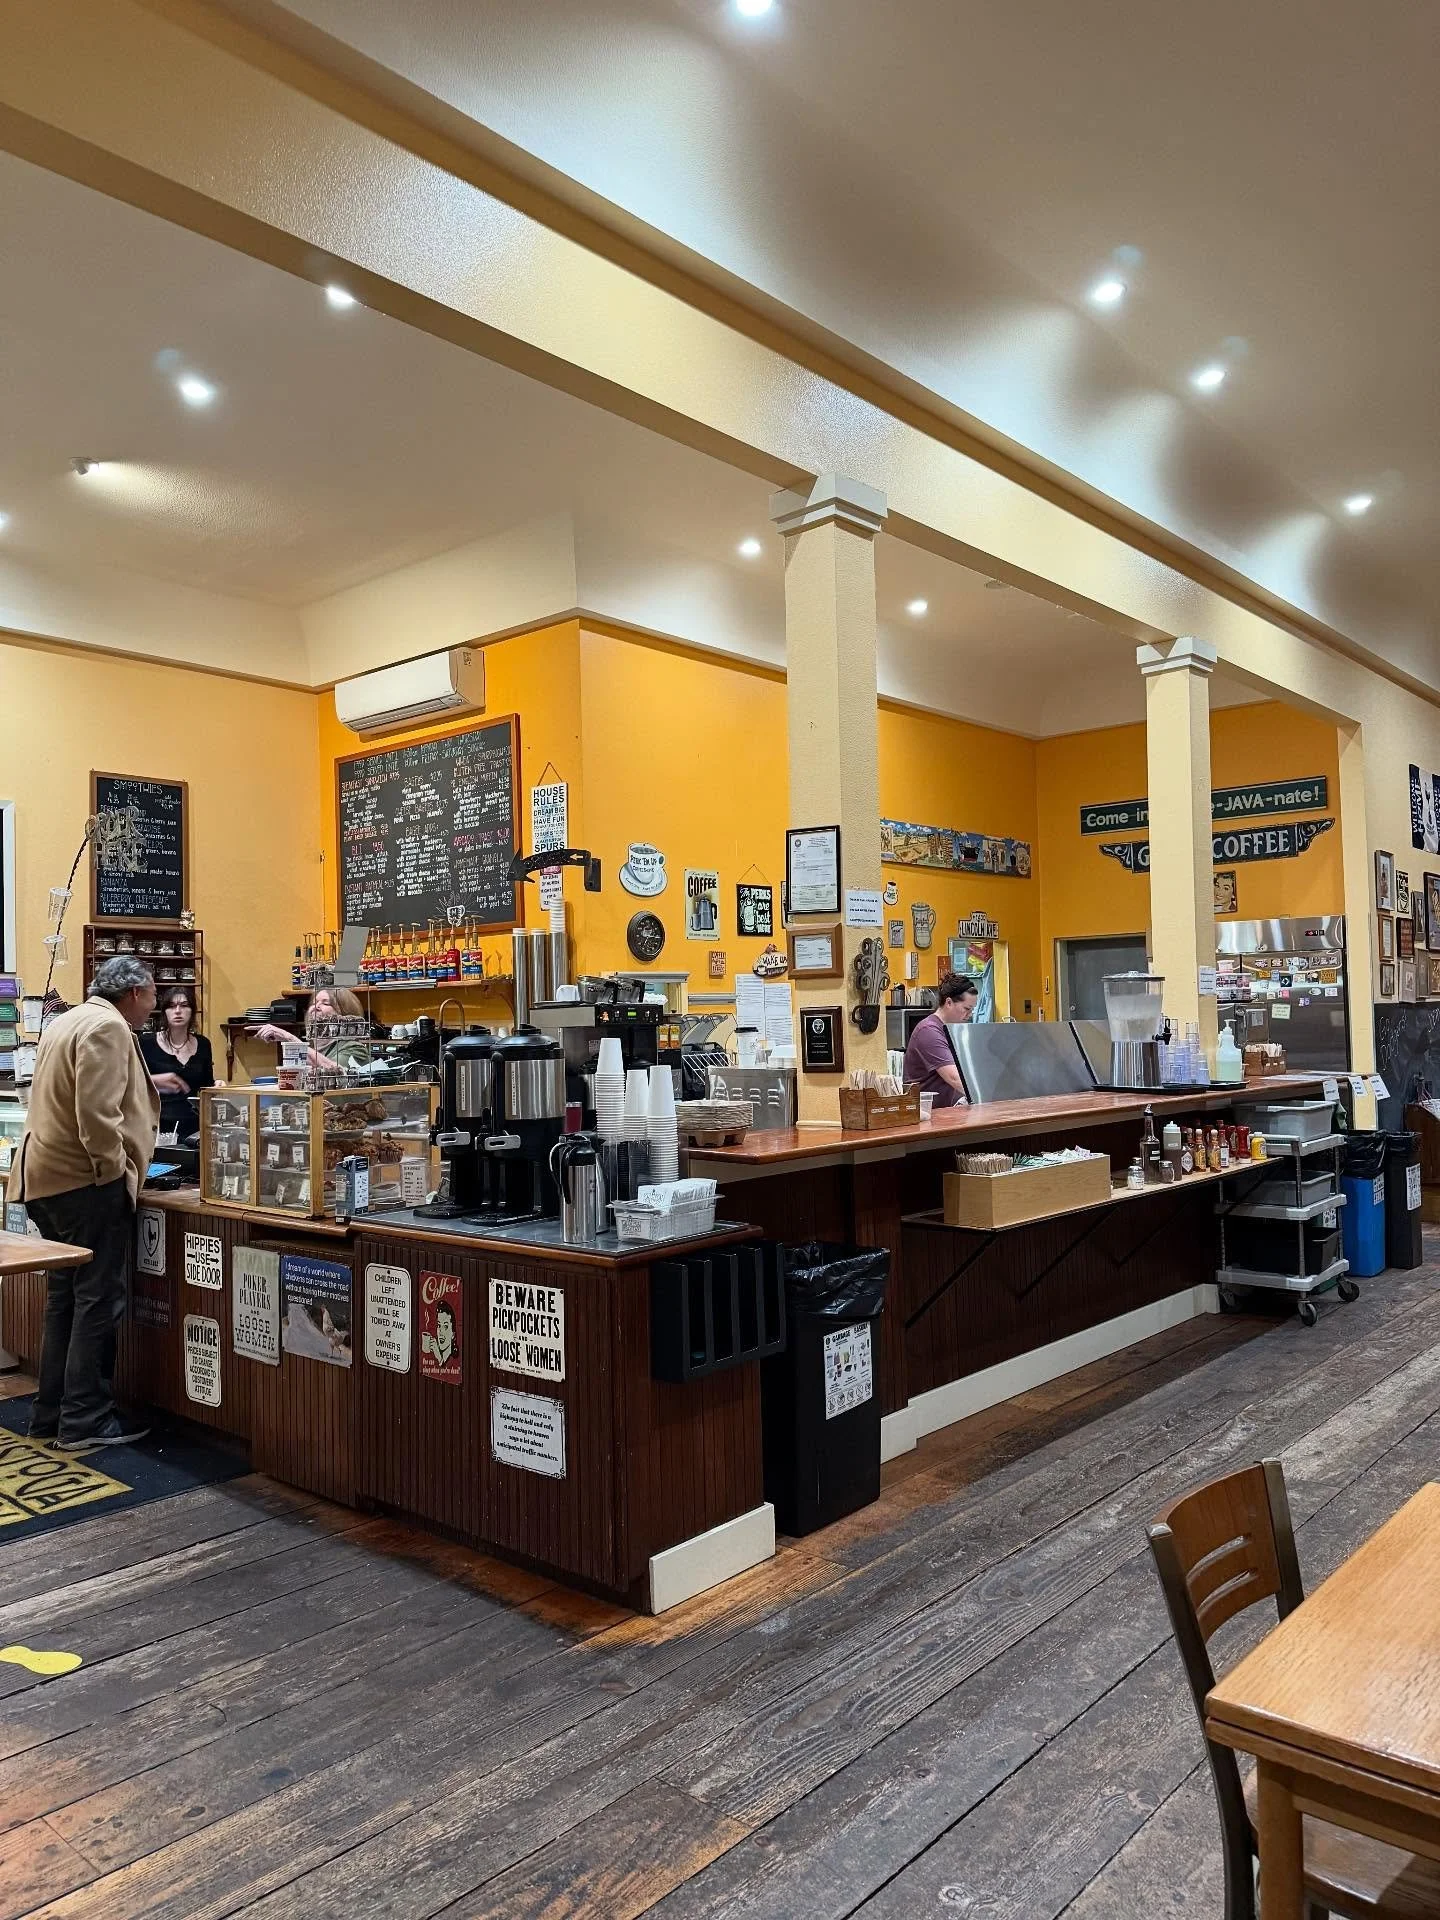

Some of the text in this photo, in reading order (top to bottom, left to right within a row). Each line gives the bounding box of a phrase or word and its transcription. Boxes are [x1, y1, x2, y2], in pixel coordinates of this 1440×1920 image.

[533, 785, 565, 799] HOUSE
[533, 794, 565, 807] RULES
[533, 806, 565, 817] DREAM BIG
[1086, 810, 1129, 828] Come
[1136, 808, 1149, 822] in
[533, 815, 565, 825] HAVE FUN
[534, 841, 565, 853] SPURS
[1212, 829, 1289, 859] COFFEE
[687, 875, 718, 897] COFFEE
[961, 921, 997, 937] LINCOLN AVE
[186, 1234, 220, 1254] HIPPIES
[195, 1252, 211, 1265] USE
[186, 1263, 221, 1285] SIDE DOOR
[375, 1273, 402, 1286] CHILDREN
[243, 1272, 267, 1293] POKER
[306, 1277, 315, 1285] can
[328, 1279, 337, 1289] the
[381, 1286, 395, 1294] LEFT
[422, 1276, 460, 1304] Coffee!
[239, 1288, 271, 1310] PLAYERS
[370, 1294, 406, 1308] UNATTENDED
[495, 1282, 556, 1314] BEWARE
[377, 1307, 400, 1318] WILL BE
[239, 1313, 270, 1335] LOOSE
[371, 1316, 390, 1327] TOWED
[492, 1306, 560, 1339] PICKPOCKETS
[187, 1323, 218, 1347] NOTICE
[235, 1327, 275, 1352] WOMEN
[187, 1345, 218, 1360] PRICES SUBJECT
[375, 1349, 401, 1362] EXPENSE
[491, 1337, 562, 1373] LOOSE WOMEN
[192, 1355, 199, 1365] TO
[210, 1369, 216, 1379] TO
[520, 1407, 530, 1416] that
